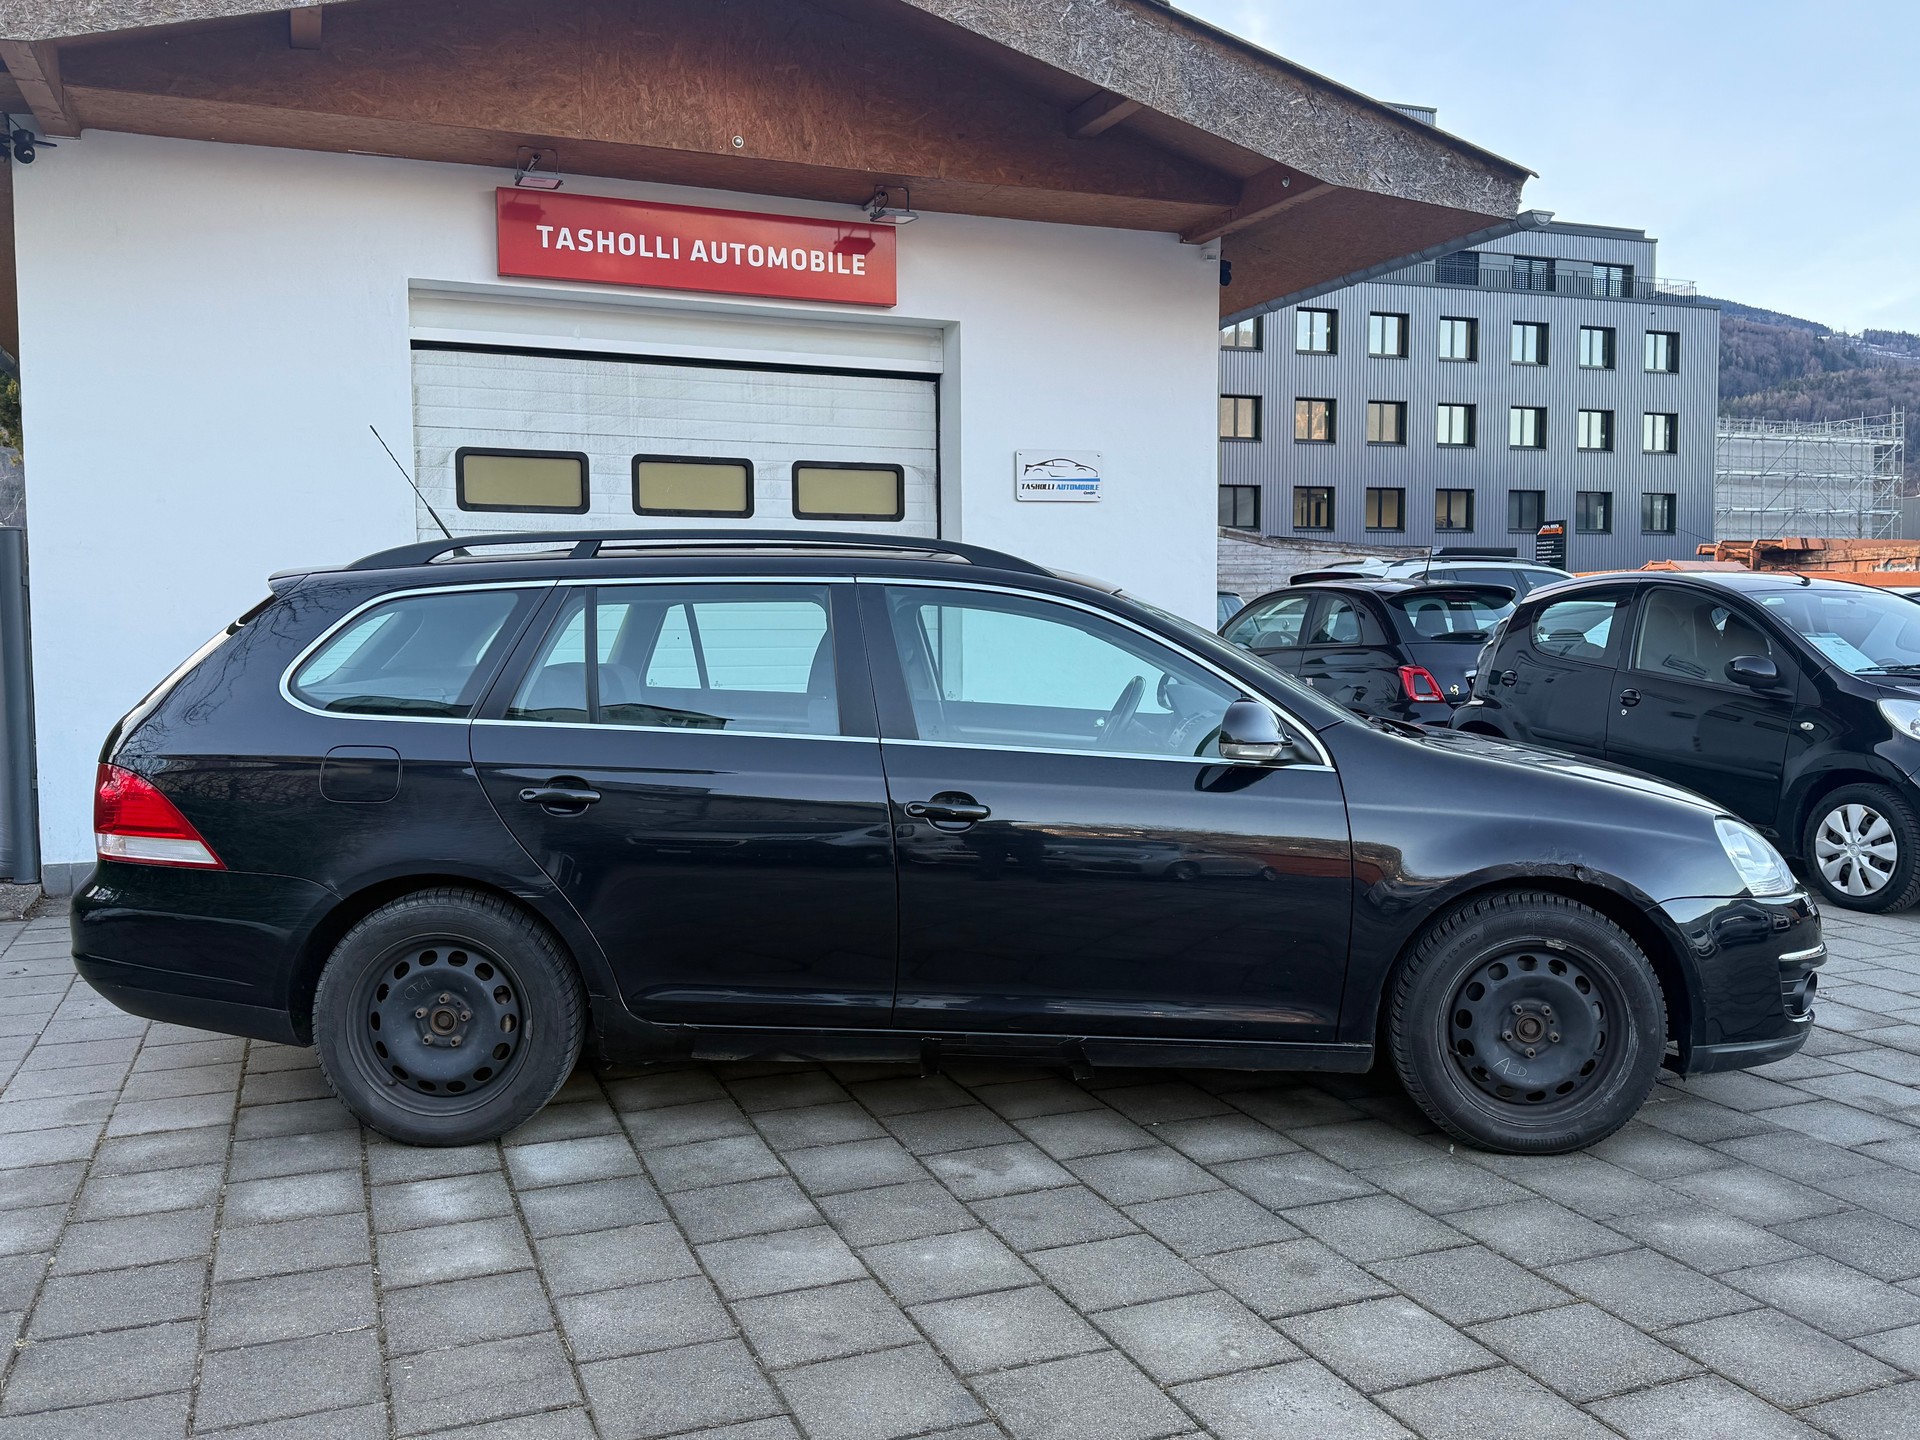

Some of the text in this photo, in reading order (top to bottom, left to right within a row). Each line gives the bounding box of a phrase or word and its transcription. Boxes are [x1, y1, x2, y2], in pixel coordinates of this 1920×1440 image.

[536, 224, 866, 276] TASHOLLI AUTOMOBILE
[1055, 483, 1100, 491] AUTOMOBILE
[1458, 932, 1479, 950] 860
